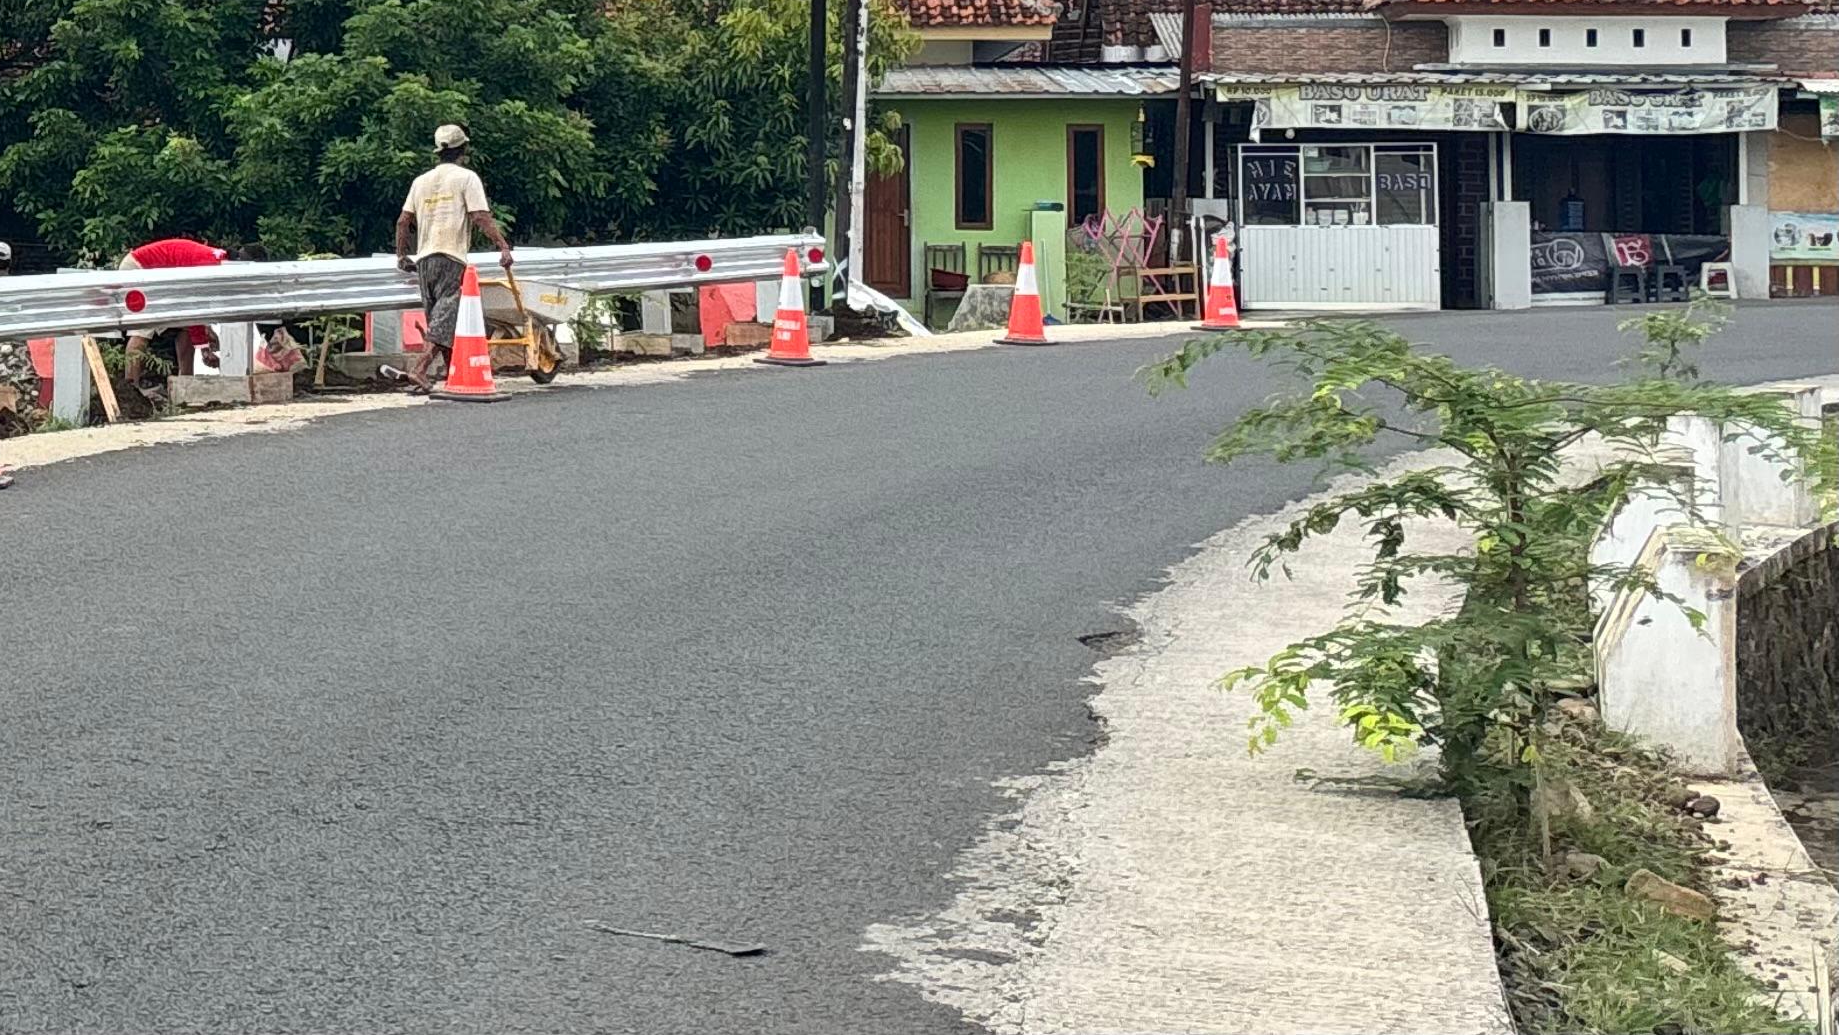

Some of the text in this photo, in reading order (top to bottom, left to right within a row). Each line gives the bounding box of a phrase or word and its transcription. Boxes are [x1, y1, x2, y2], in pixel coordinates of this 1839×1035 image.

[1299, 83, 1359, 101] BASO
[1363, 82, 1431, 102] URAT
[1377, 171, 1432, 192] BASO
[1247, 182, 1298, 202] AYAM
